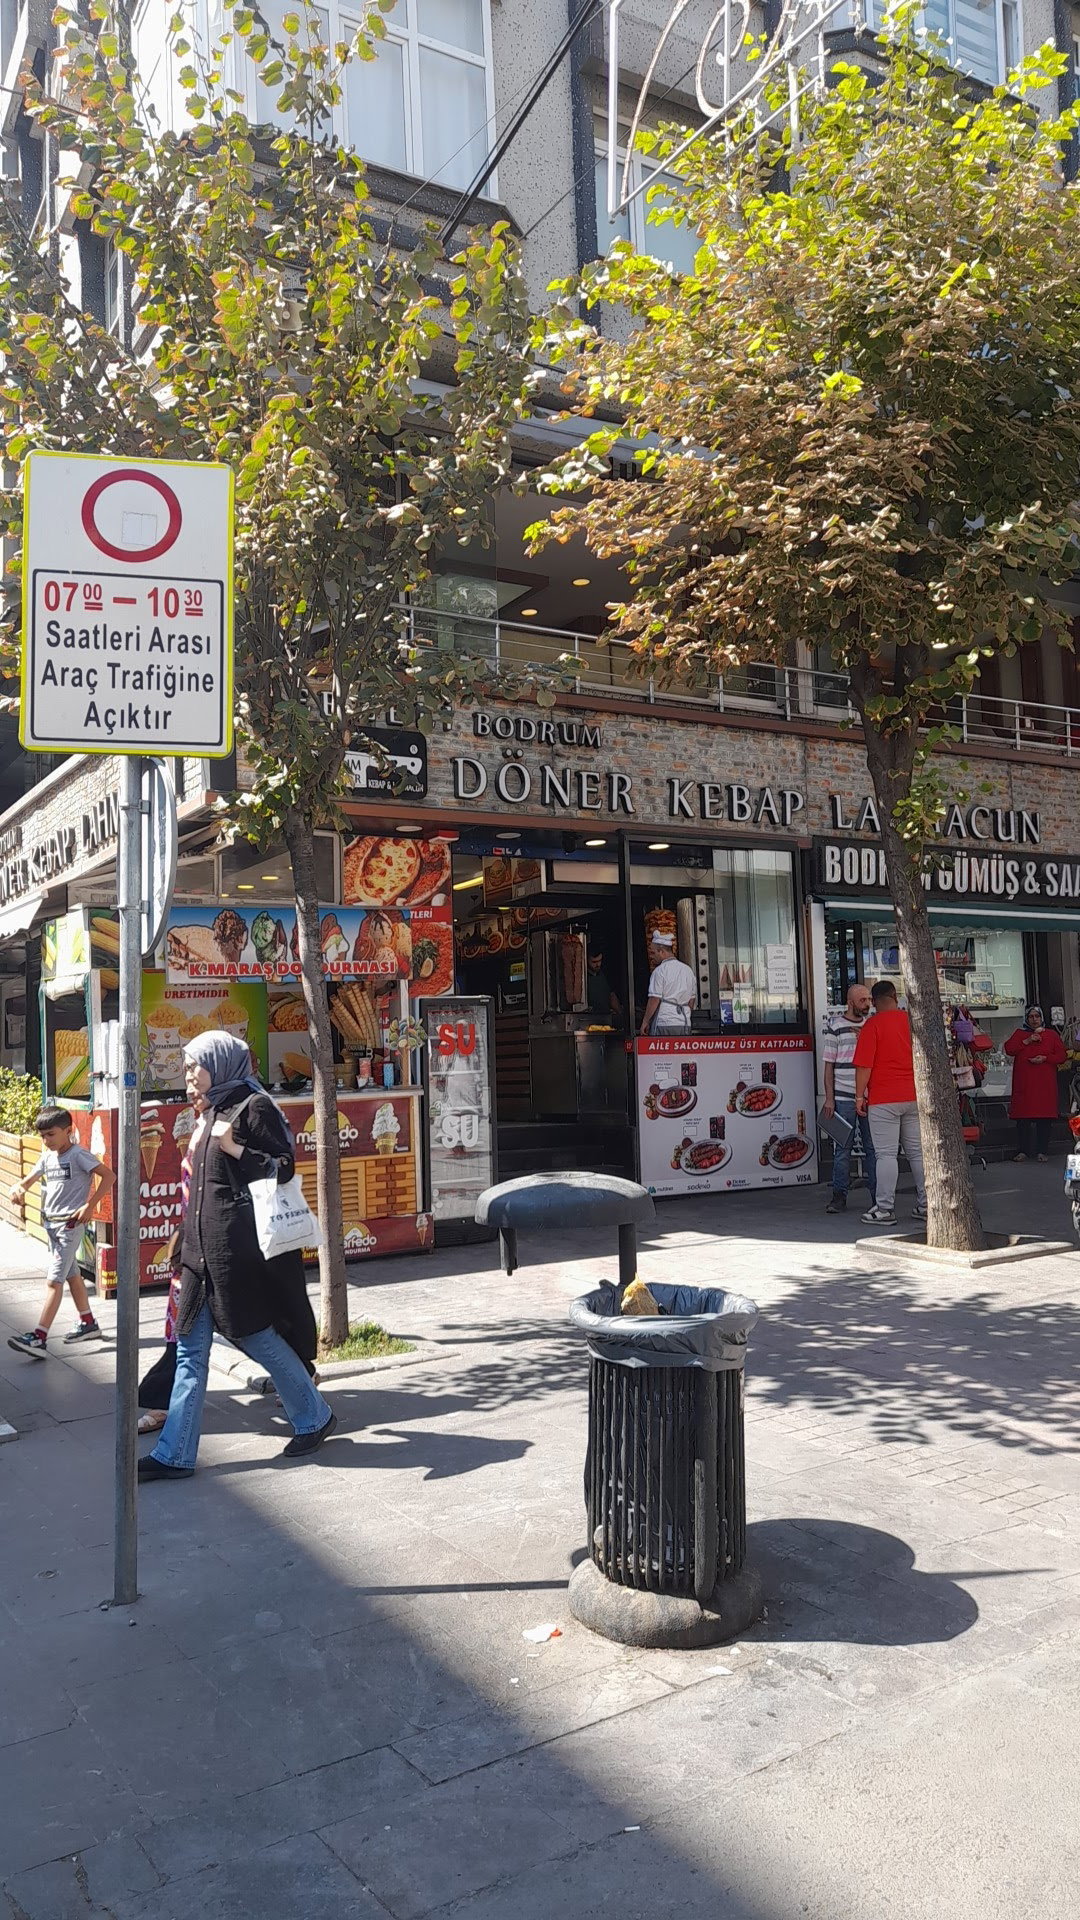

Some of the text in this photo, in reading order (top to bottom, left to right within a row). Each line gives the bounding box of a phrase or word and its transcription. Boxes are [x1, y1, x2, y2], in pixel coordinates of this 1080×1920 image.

[46, 620, 211, 655] Saatleri Arası
[41, 659, 214, 698] Araç Trafiğine
[83, 700, 172, 734] Açıktır
[474, 712, 601, 749] BODRUM
[368, 779, 386, 789] KEBAP
[453, 749, 1041, 844] DÖNER KEBAP LAACUN
[31, 827, 75, 881] KEBAP
[80, 791, 121, 851] LAHM
[938, 851, 1020, 900] GÜMÜŞ
[1023, 860, 1041, 894] &
[410, 908, 433, 919] TLERİ
[188, 960, 397, 981] K.MARAŞ DOURMASI
[438, 1023, 475, 1056] SU
[649, 1040, 669, 1050] AİLE
[674, 1039, 736, 1050] SALONUMUZ
[739, 1038, 756, 1048] ÜST
[442, 1115, 479, 1149] SU
[796, 1174, 811, 1183] VISA
[343, 1234, 377, 1249] arfedo
[344, 1247, 371, 1256] NDURMA
[153, 1272, 174, 1281] DOND
